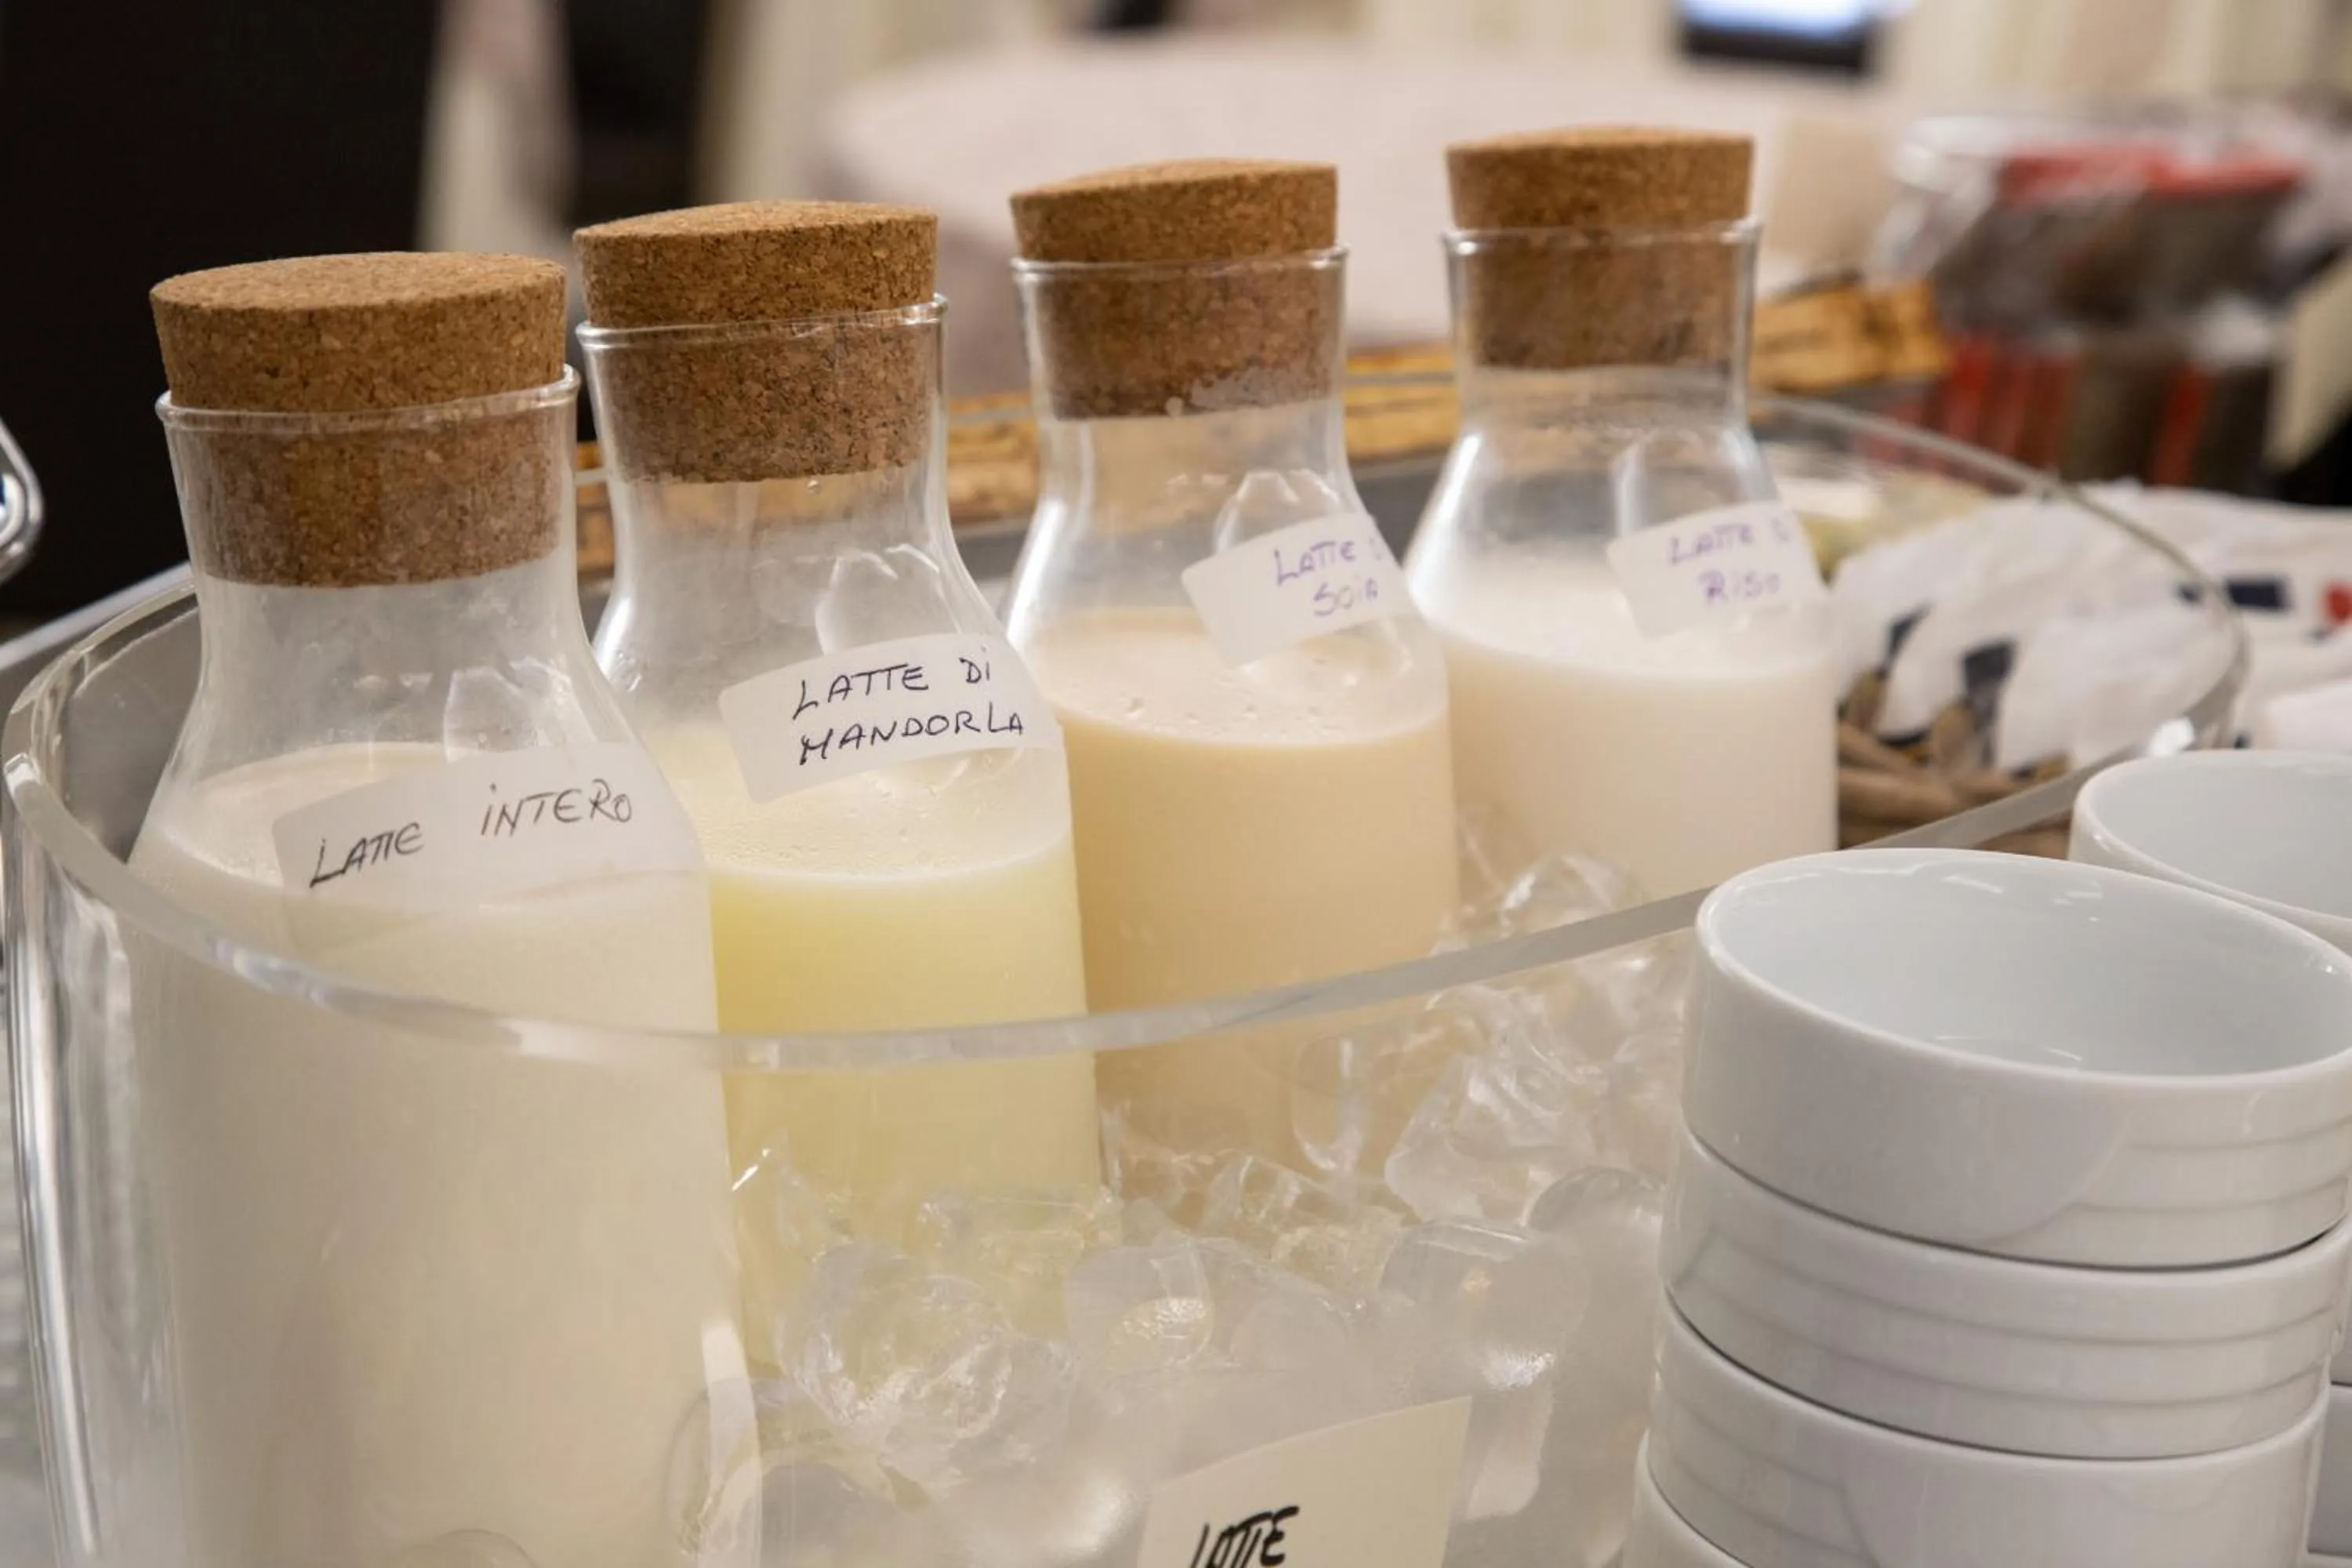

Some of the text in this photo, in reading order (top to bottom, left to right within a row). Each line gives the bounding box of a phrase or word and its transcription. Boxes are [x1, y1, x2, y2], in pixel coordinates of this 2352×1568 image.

[1273, 539, 1357, 586] LATTE
[793, 663, 929, 720] LATTE
[798, 702, 1024, 765] MANDORLA
[309, 822, 425, 888] LATTE
